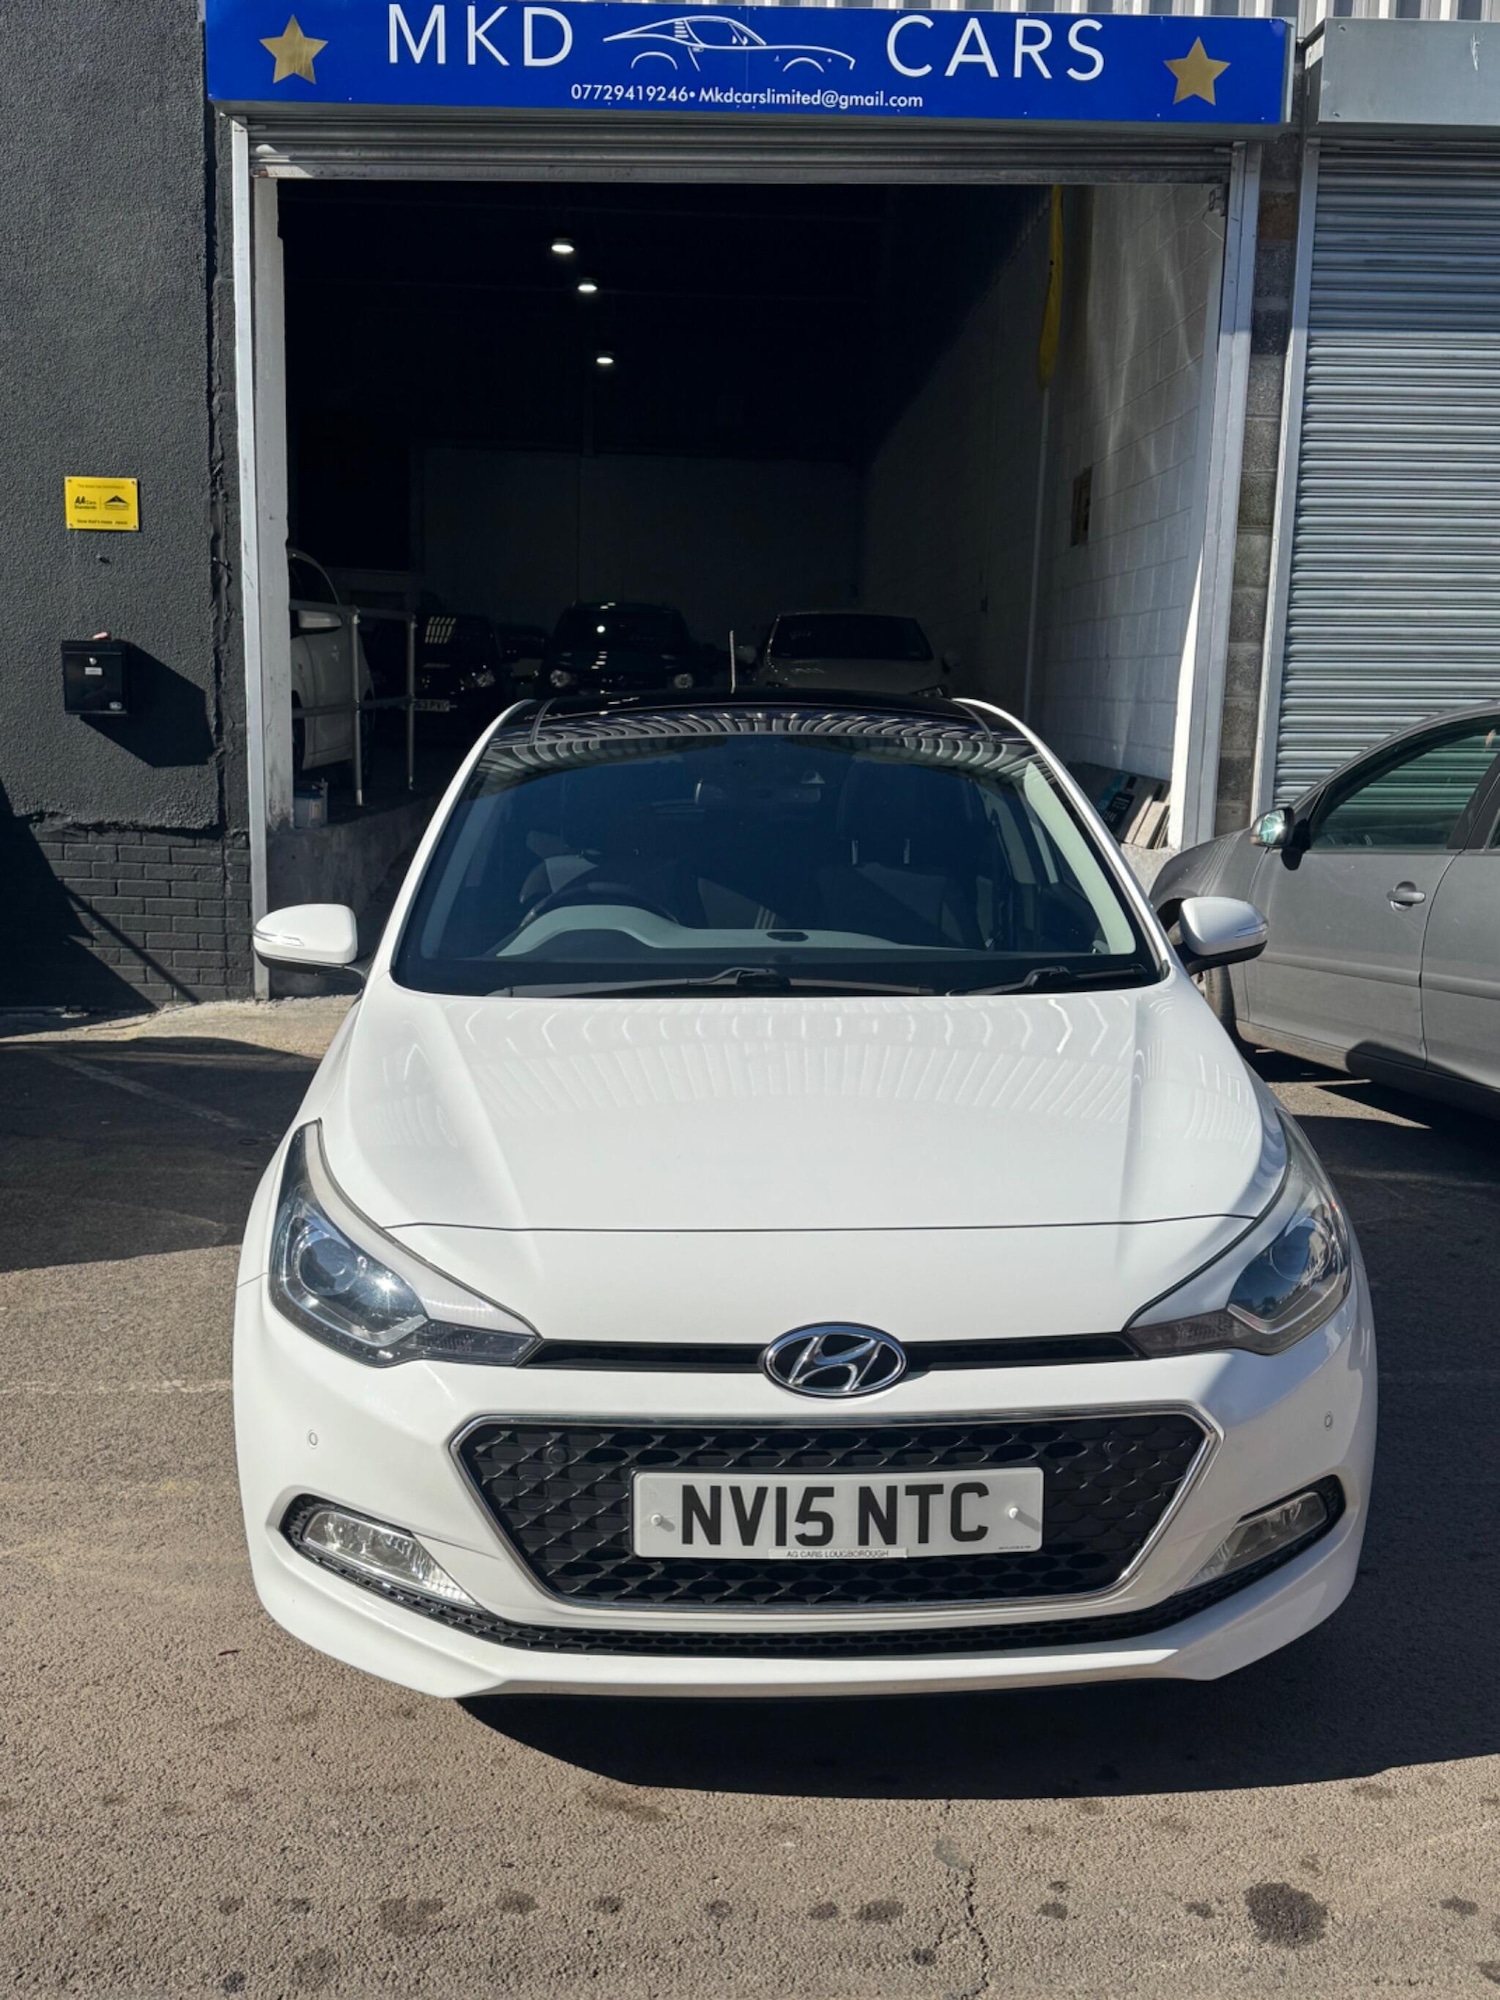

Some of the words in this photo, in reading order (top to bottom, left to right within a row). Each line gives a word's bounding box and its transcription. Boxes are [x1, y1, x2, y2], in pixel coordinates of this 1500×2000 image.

[388, 3, 573, 67] MKD
[886, 14, 1104, 81] CARS
[570, 83, 689, 102] 07729419246
[698, 86, 923, 110] Mkdcarslimited@gmail.com
[682, 1484, 835, 1547] NV15
[857, 1481, 989, 1546] NTC
